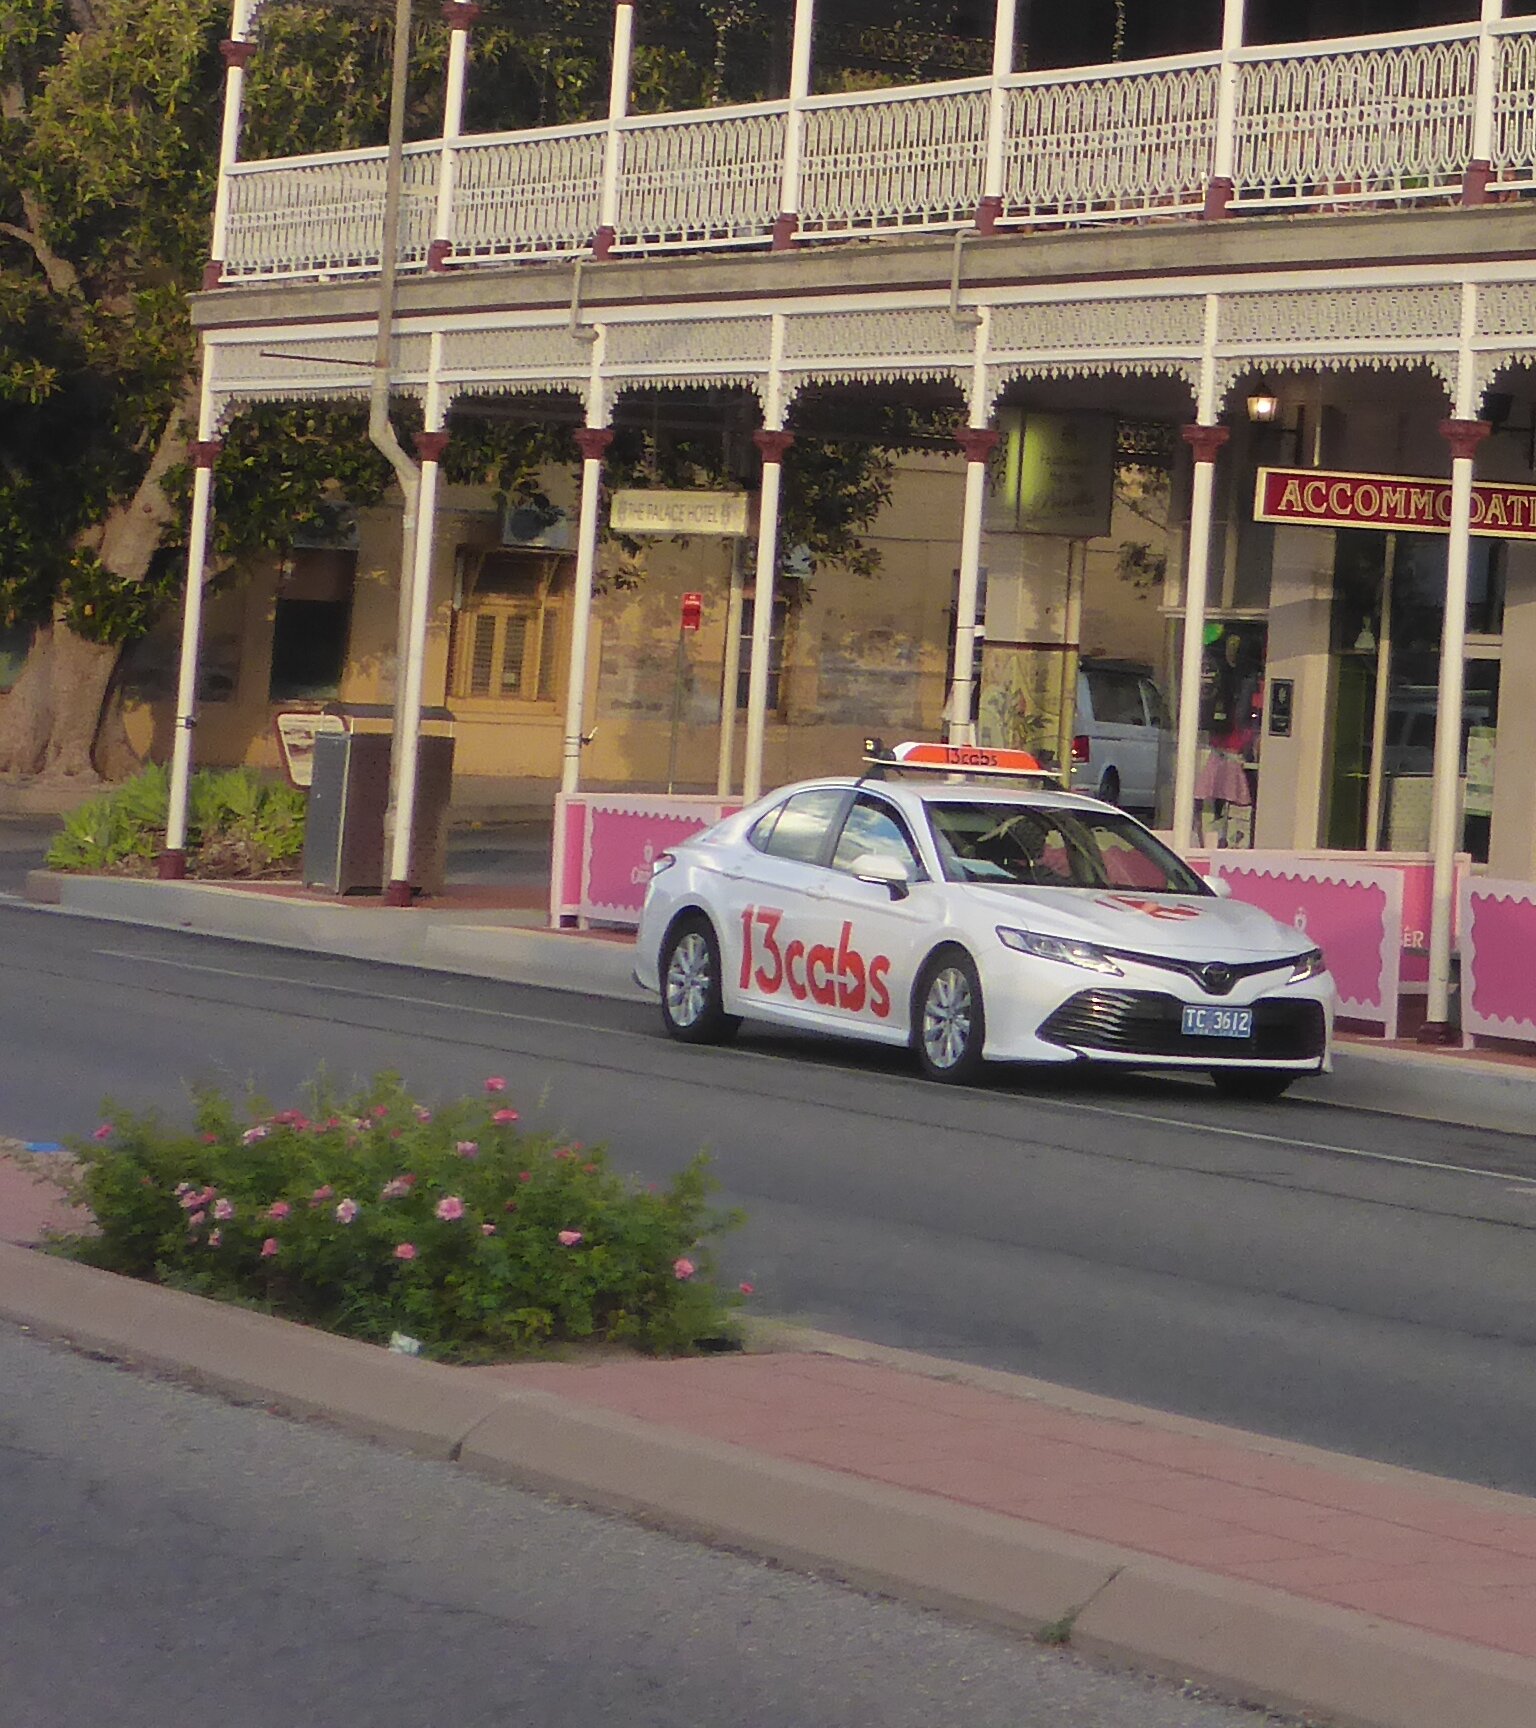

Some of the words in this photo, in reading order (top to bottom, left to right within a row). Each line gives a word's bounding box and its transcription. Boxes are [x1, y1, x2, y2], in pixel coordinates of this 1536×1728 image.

[945, 747, 998, 766] 13cabs
[740, 904, 891, 1018] 13cabs
[1186, 1009, 1207, 1028] TC
[1213, 1011, 1249, 1031] 3612
